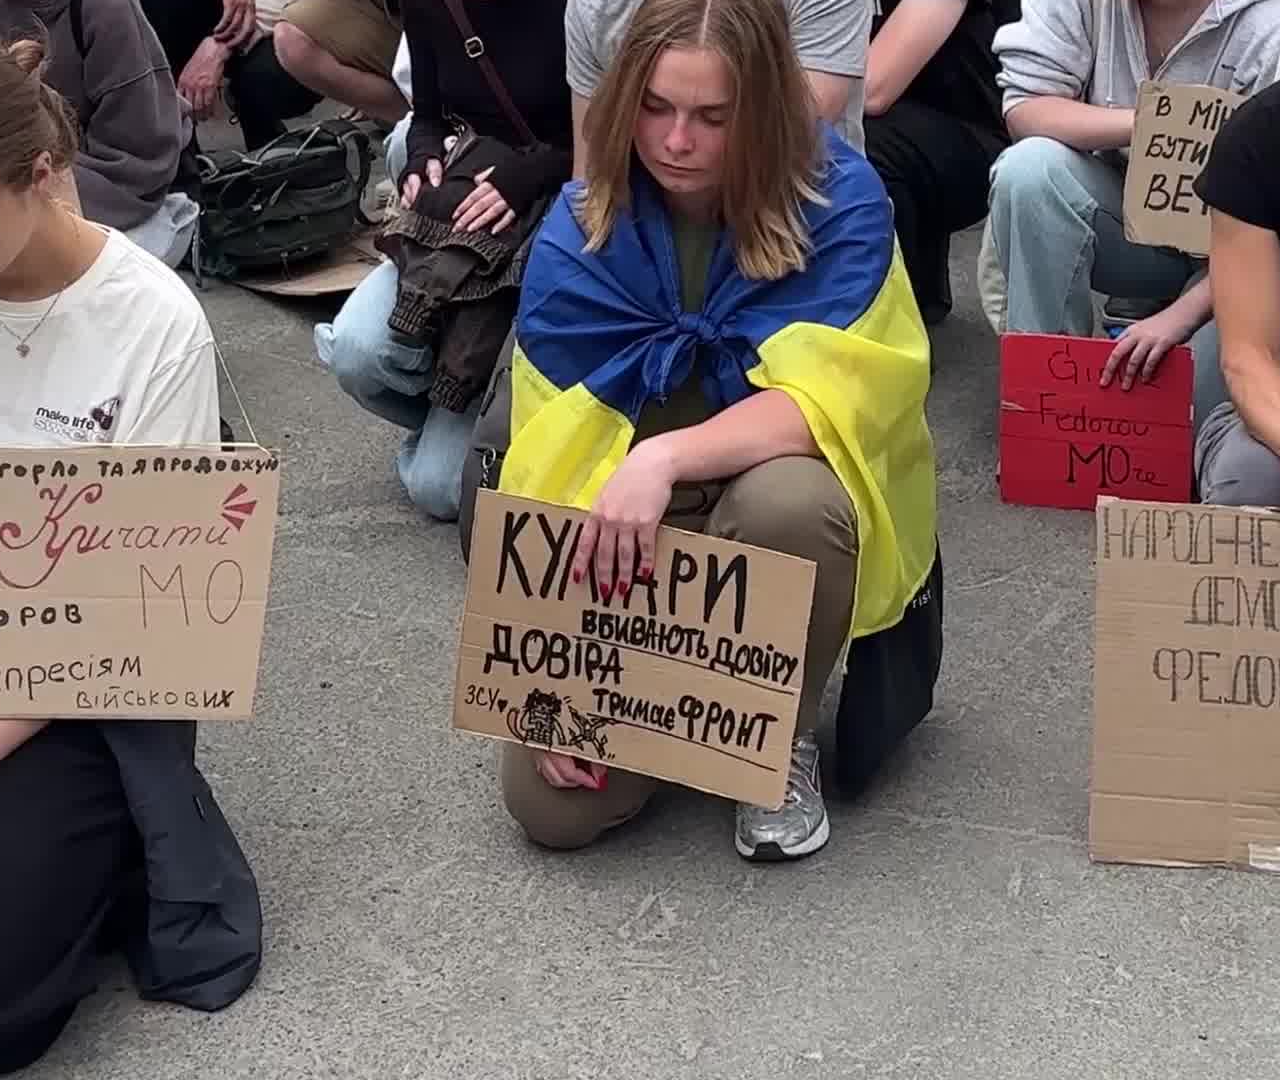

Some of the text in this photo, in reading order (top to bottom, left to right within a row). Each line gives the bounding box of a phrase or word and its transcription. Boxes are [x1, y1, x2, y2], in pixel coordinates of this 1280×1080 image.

[36, 407, 95, 430] make life
[582, 609, 709, 661] ВБИВАЮТЬ
[677, 695, 779, 752] ФРОНТ
